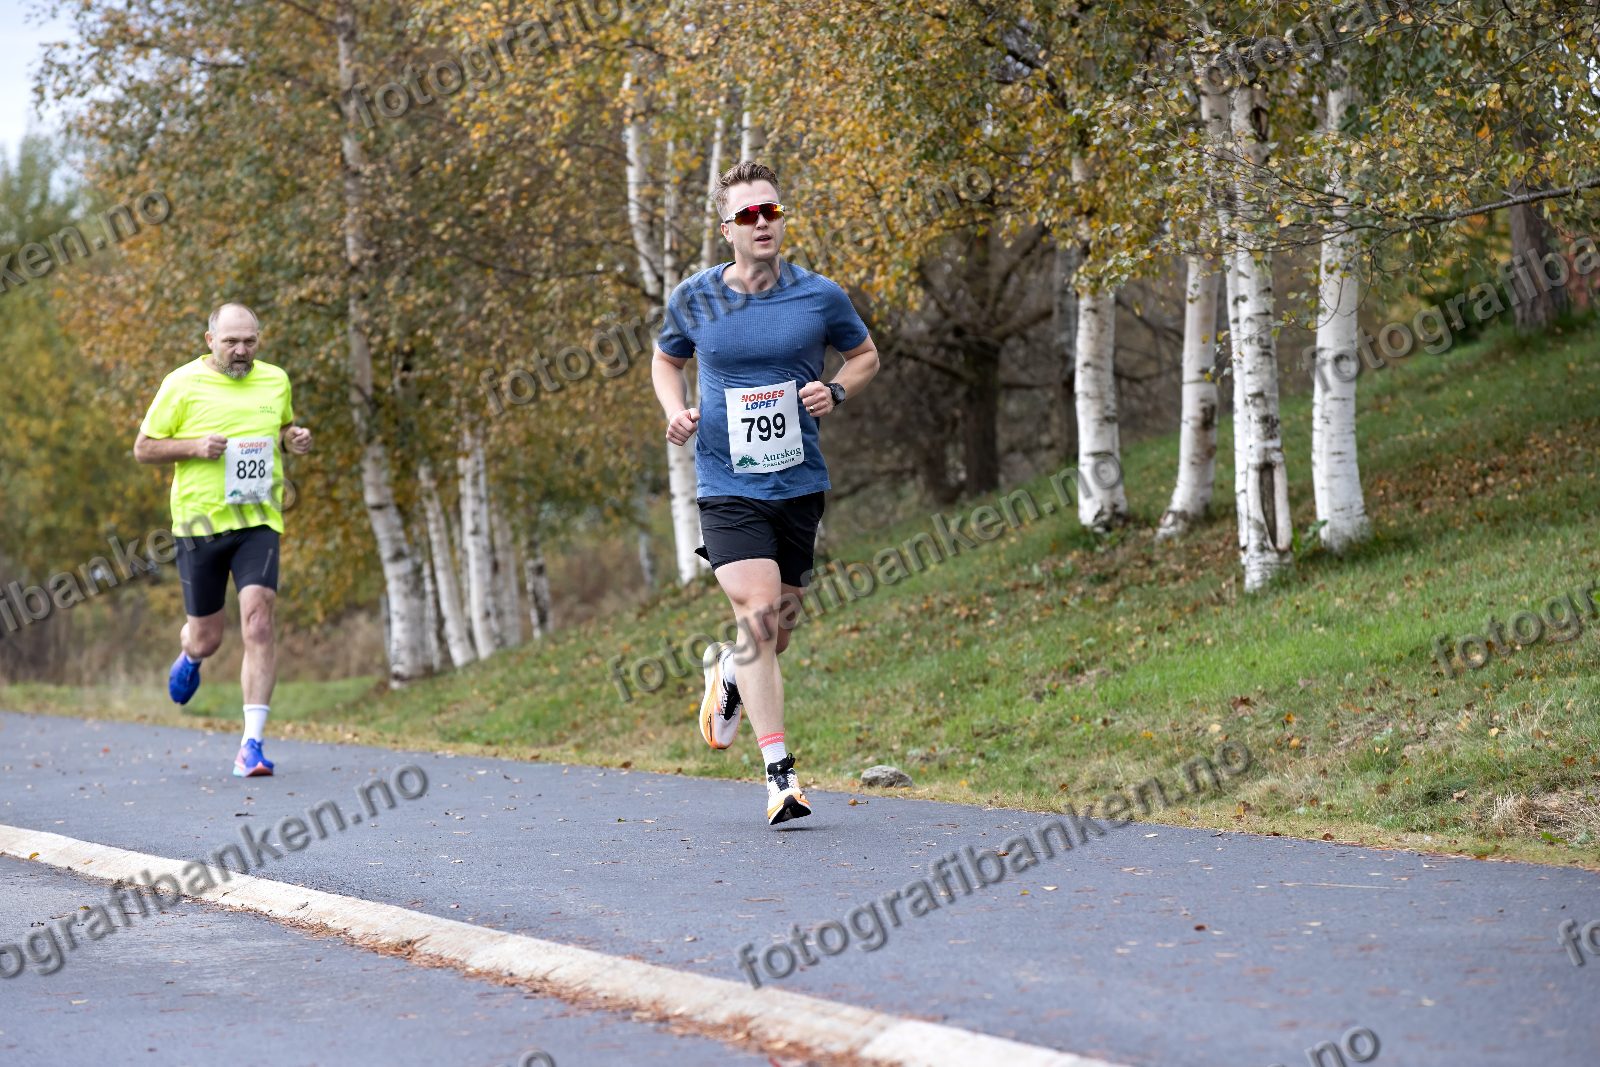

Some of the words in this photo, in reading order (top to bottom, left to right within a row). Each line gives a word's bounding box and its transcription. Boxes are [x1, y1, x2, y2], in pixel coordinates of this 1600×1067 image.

[740, 389, 785, 403] NORGES
[745, 399, 779, 411] LØPET
[741, 412, 786, 443] 799
[762, 447, 802, 463] Aurskog
[236, 459, 266, 480] 828
